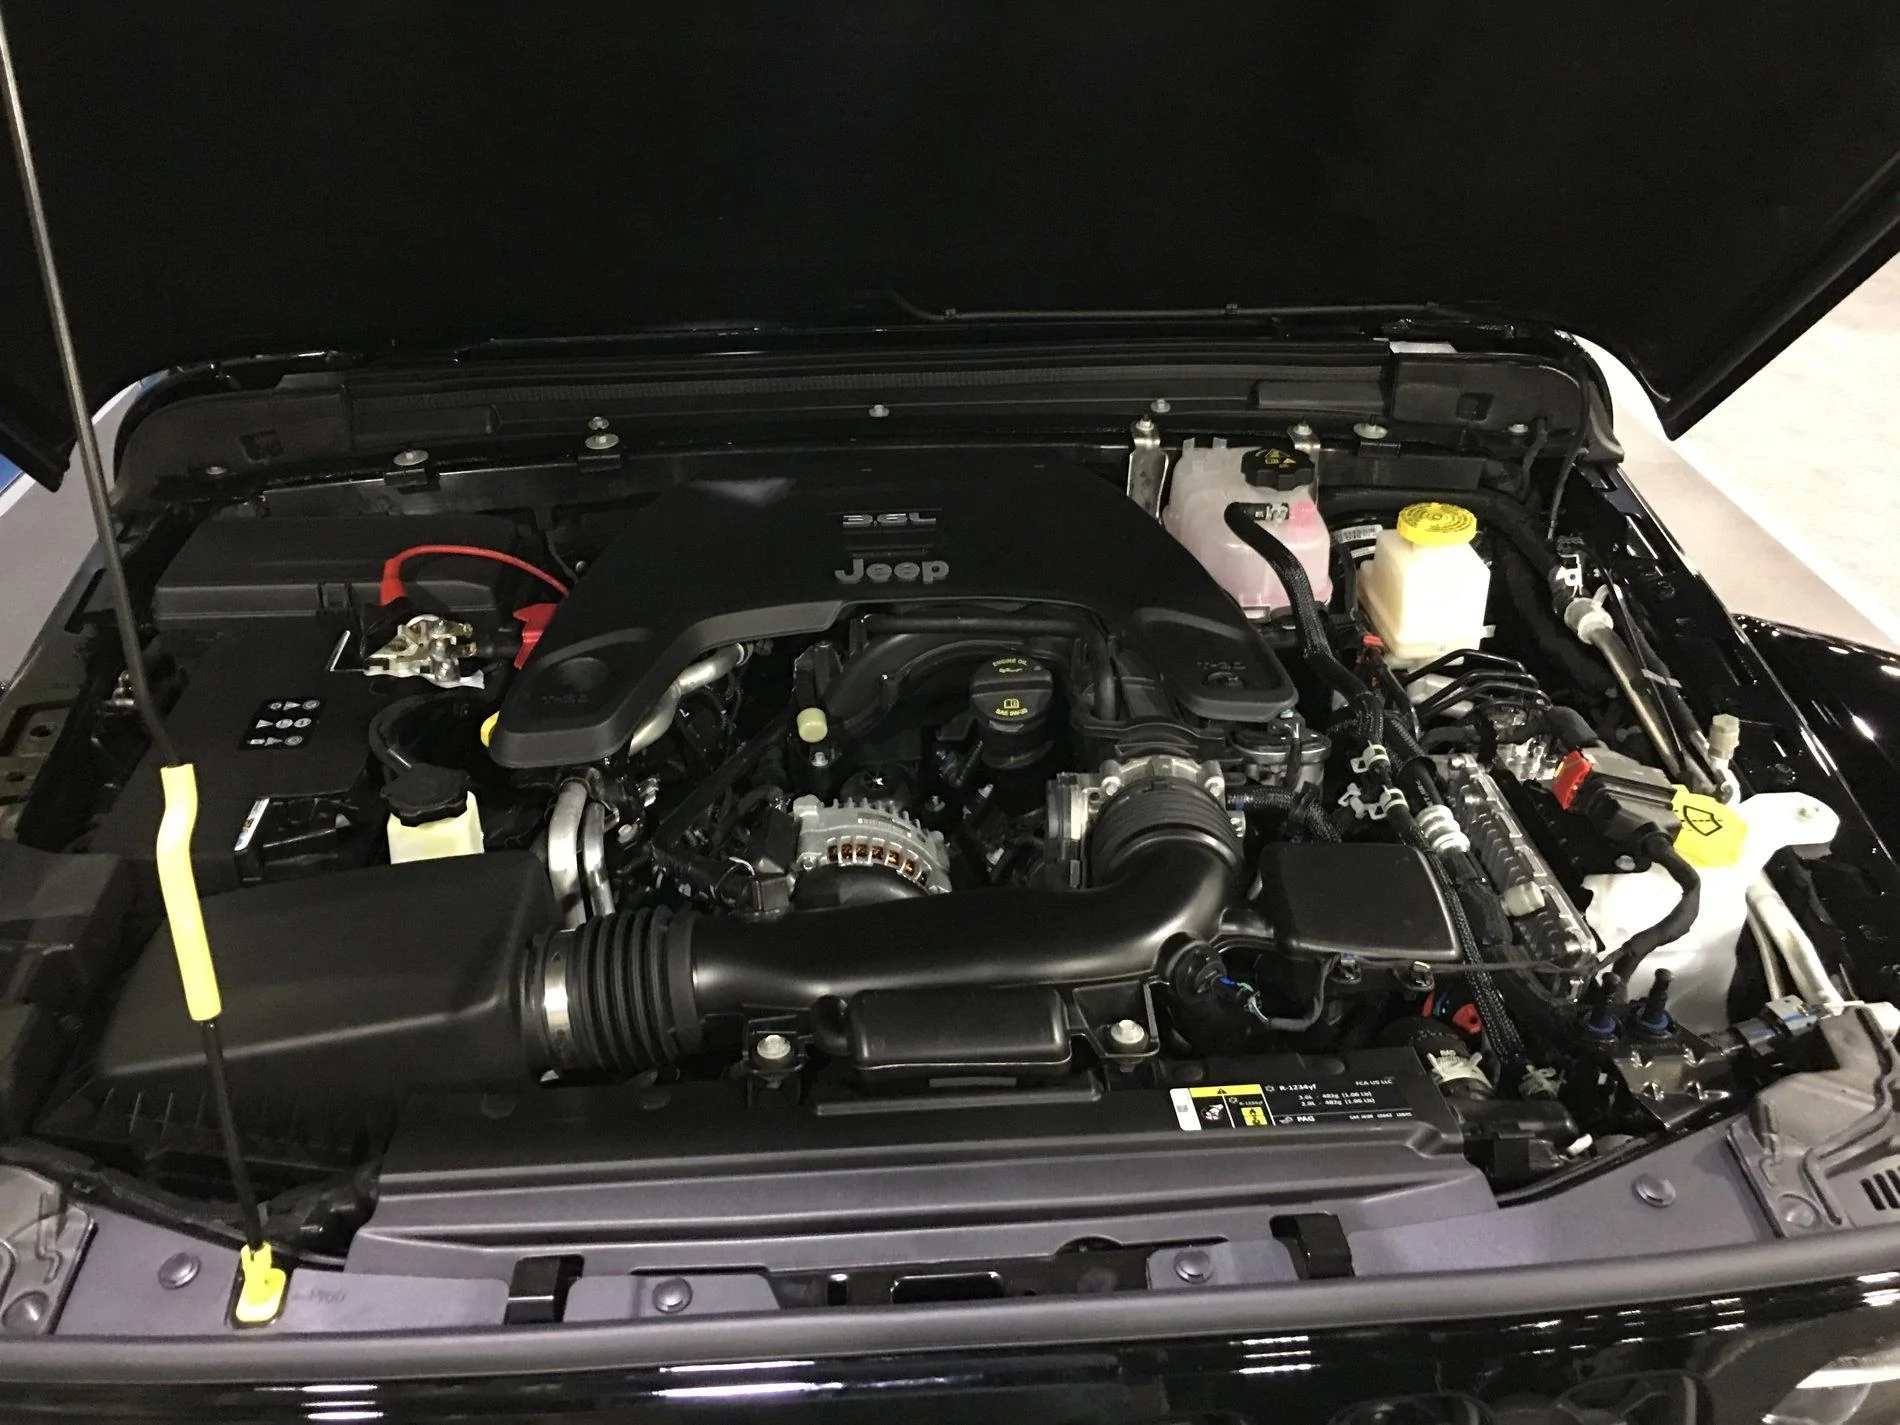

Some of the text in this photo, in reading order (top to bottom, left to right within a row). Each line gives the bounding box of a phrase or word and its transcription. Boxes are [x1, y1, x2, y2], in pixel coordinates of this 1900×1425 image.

[842, 512, 937, 529] 3.6L
[834, 558, 950, 585] Jeep
[992, 658, 1017, 667] ENGINE
[1279, 1083, 1317, 1092] R-1234yf
[1296, 1115, 1316, 1123] PAG
